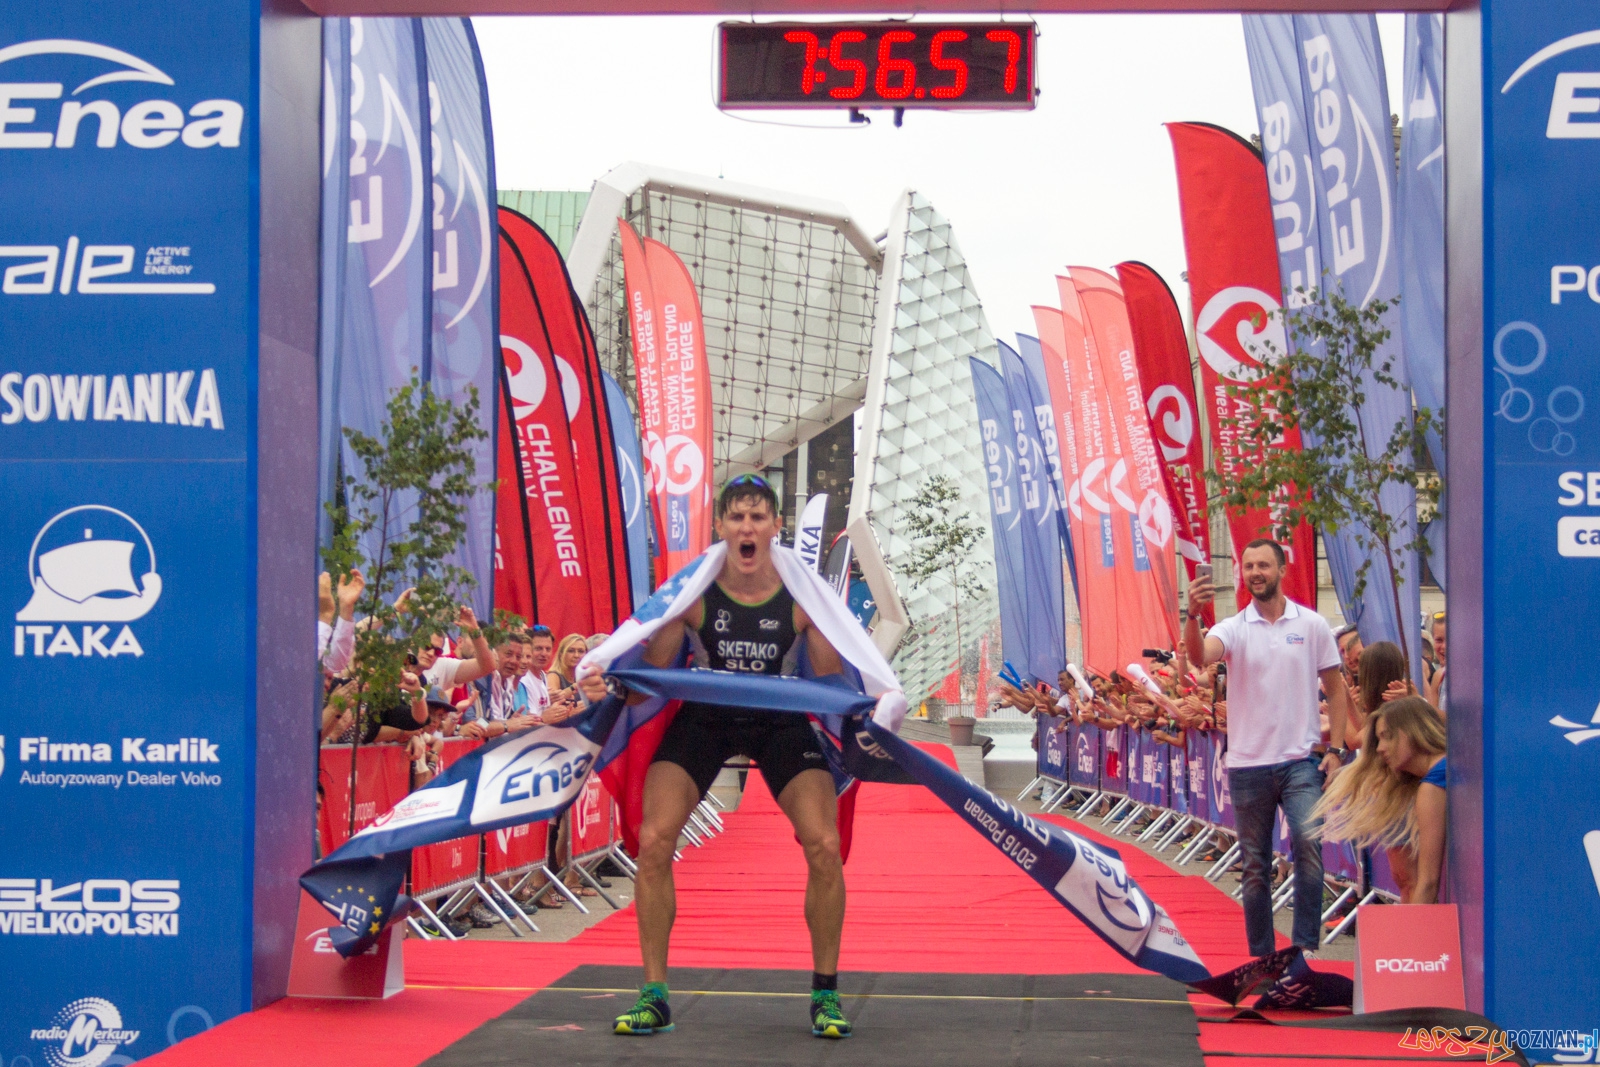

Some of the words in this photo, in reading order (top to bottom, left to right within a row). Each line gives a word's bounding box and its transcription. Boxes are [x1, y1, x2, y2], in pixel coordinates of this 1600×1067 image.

[0, 82, 245, 149] Enea
[145, 256, 173, 265] LIFE
[146, 247, 191, 256] ACTIVE
[143, 265, 193, 275] ENERGY
[1, 368, 225, 430] SOWIANKA
[526, 423, 582, 577] CHALLENGE
[14, 624, 144, 658] ITAKA
[717, 640, 778, 659] SKETAKO
[725, 659, 766, 672] SLO
[19, 737, 113, 763] Firma
[121, 737, 220, 763] Karlik
[19, 770, 124, 789] Autoryzowany
[126, 771, 180, 786] Dealer
[181, 771, 222, 786] Volvo
[500, 752, 593, 804] Enea
[963, 798, 1006, 844] Poznan
[1001, 833, 1038, 870] 2016
[1079, 841, 1130, 894] nea
[0, 912, 179, 936] WIELKOPOLSKI
